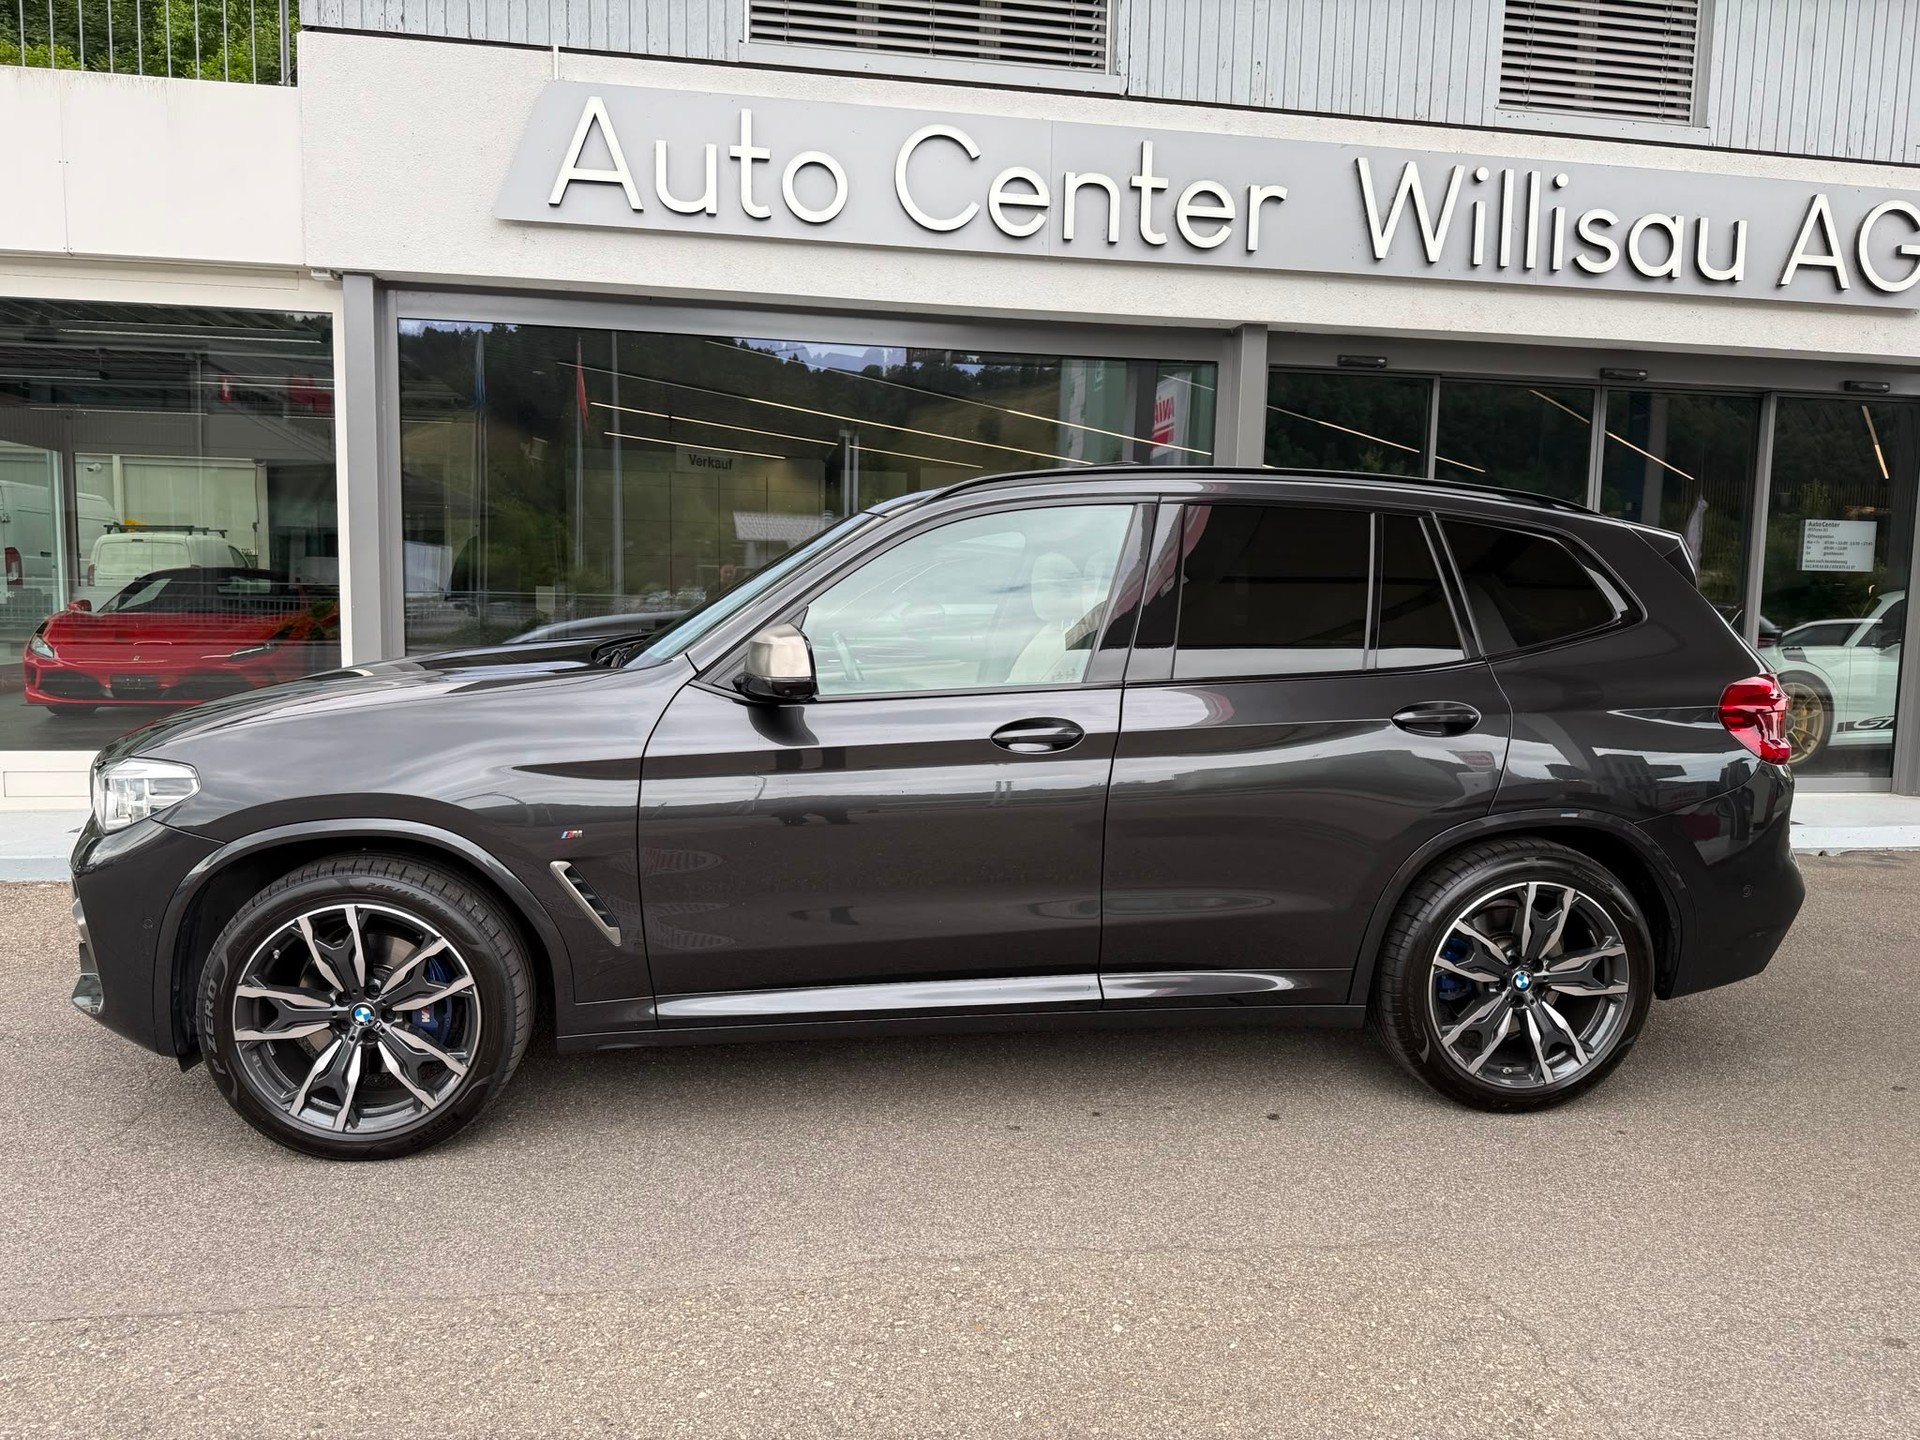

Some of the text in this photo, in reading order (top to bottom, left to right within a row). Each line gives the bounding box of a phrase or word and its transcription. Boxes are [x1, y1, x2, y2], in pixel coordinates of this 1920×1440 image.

[548, 95, 1920, 293] Auto Center Willisau AG
[688, 454, 733, 470] Verkauf
[204, 978, 218, 1054] ZERO
